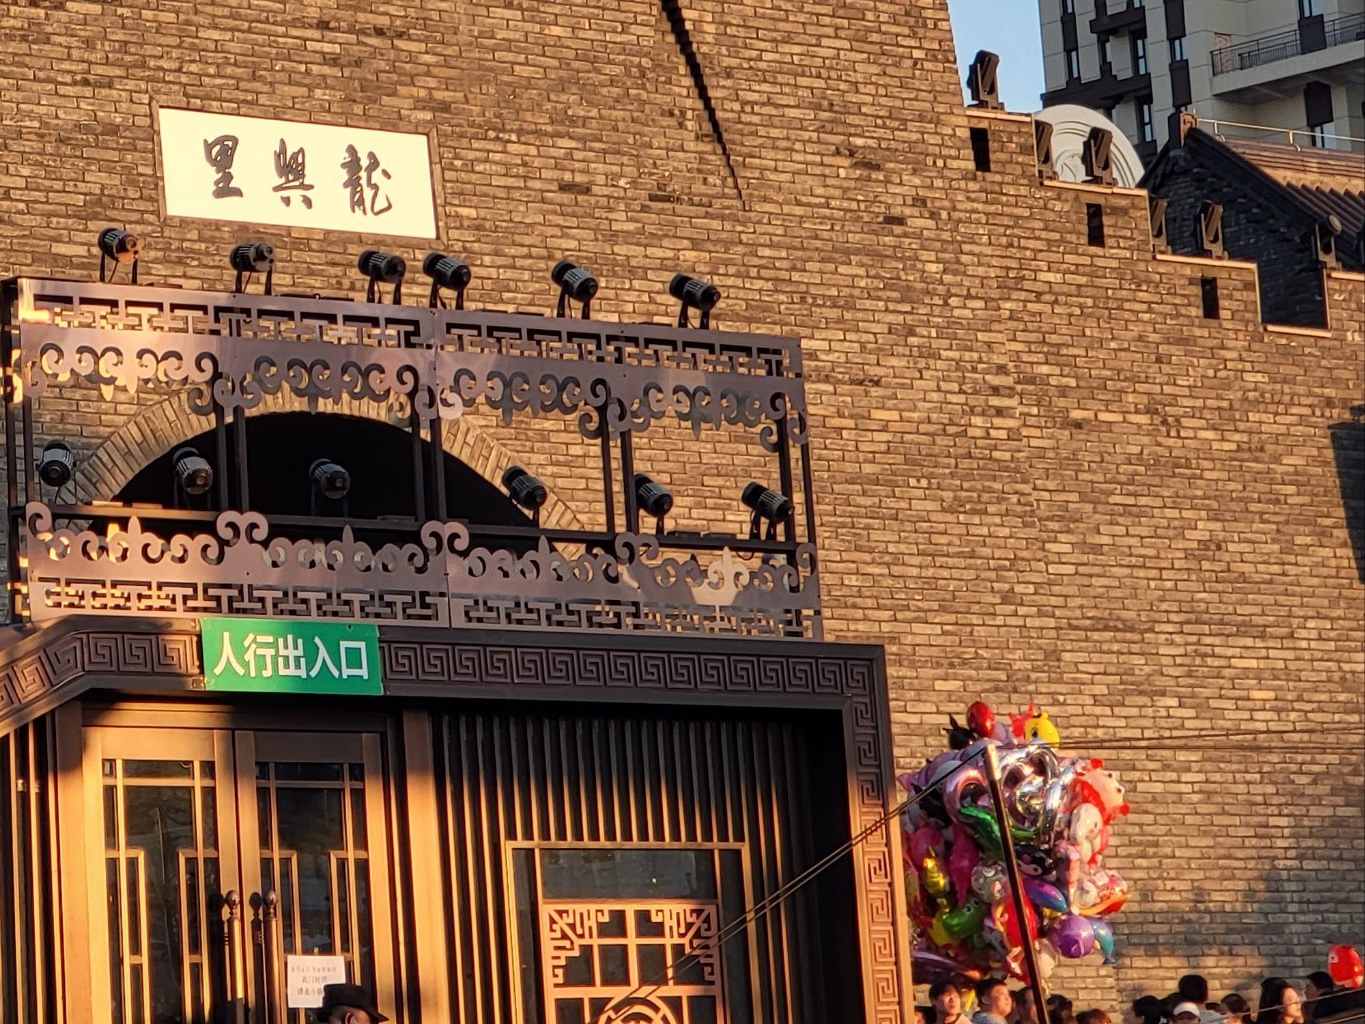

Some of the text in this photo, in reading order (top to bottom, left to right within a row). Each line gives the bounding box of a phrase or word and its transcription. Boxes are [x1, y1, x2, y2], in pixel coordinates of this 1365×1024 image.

[213, 631, 369, 679] 人行出入口
